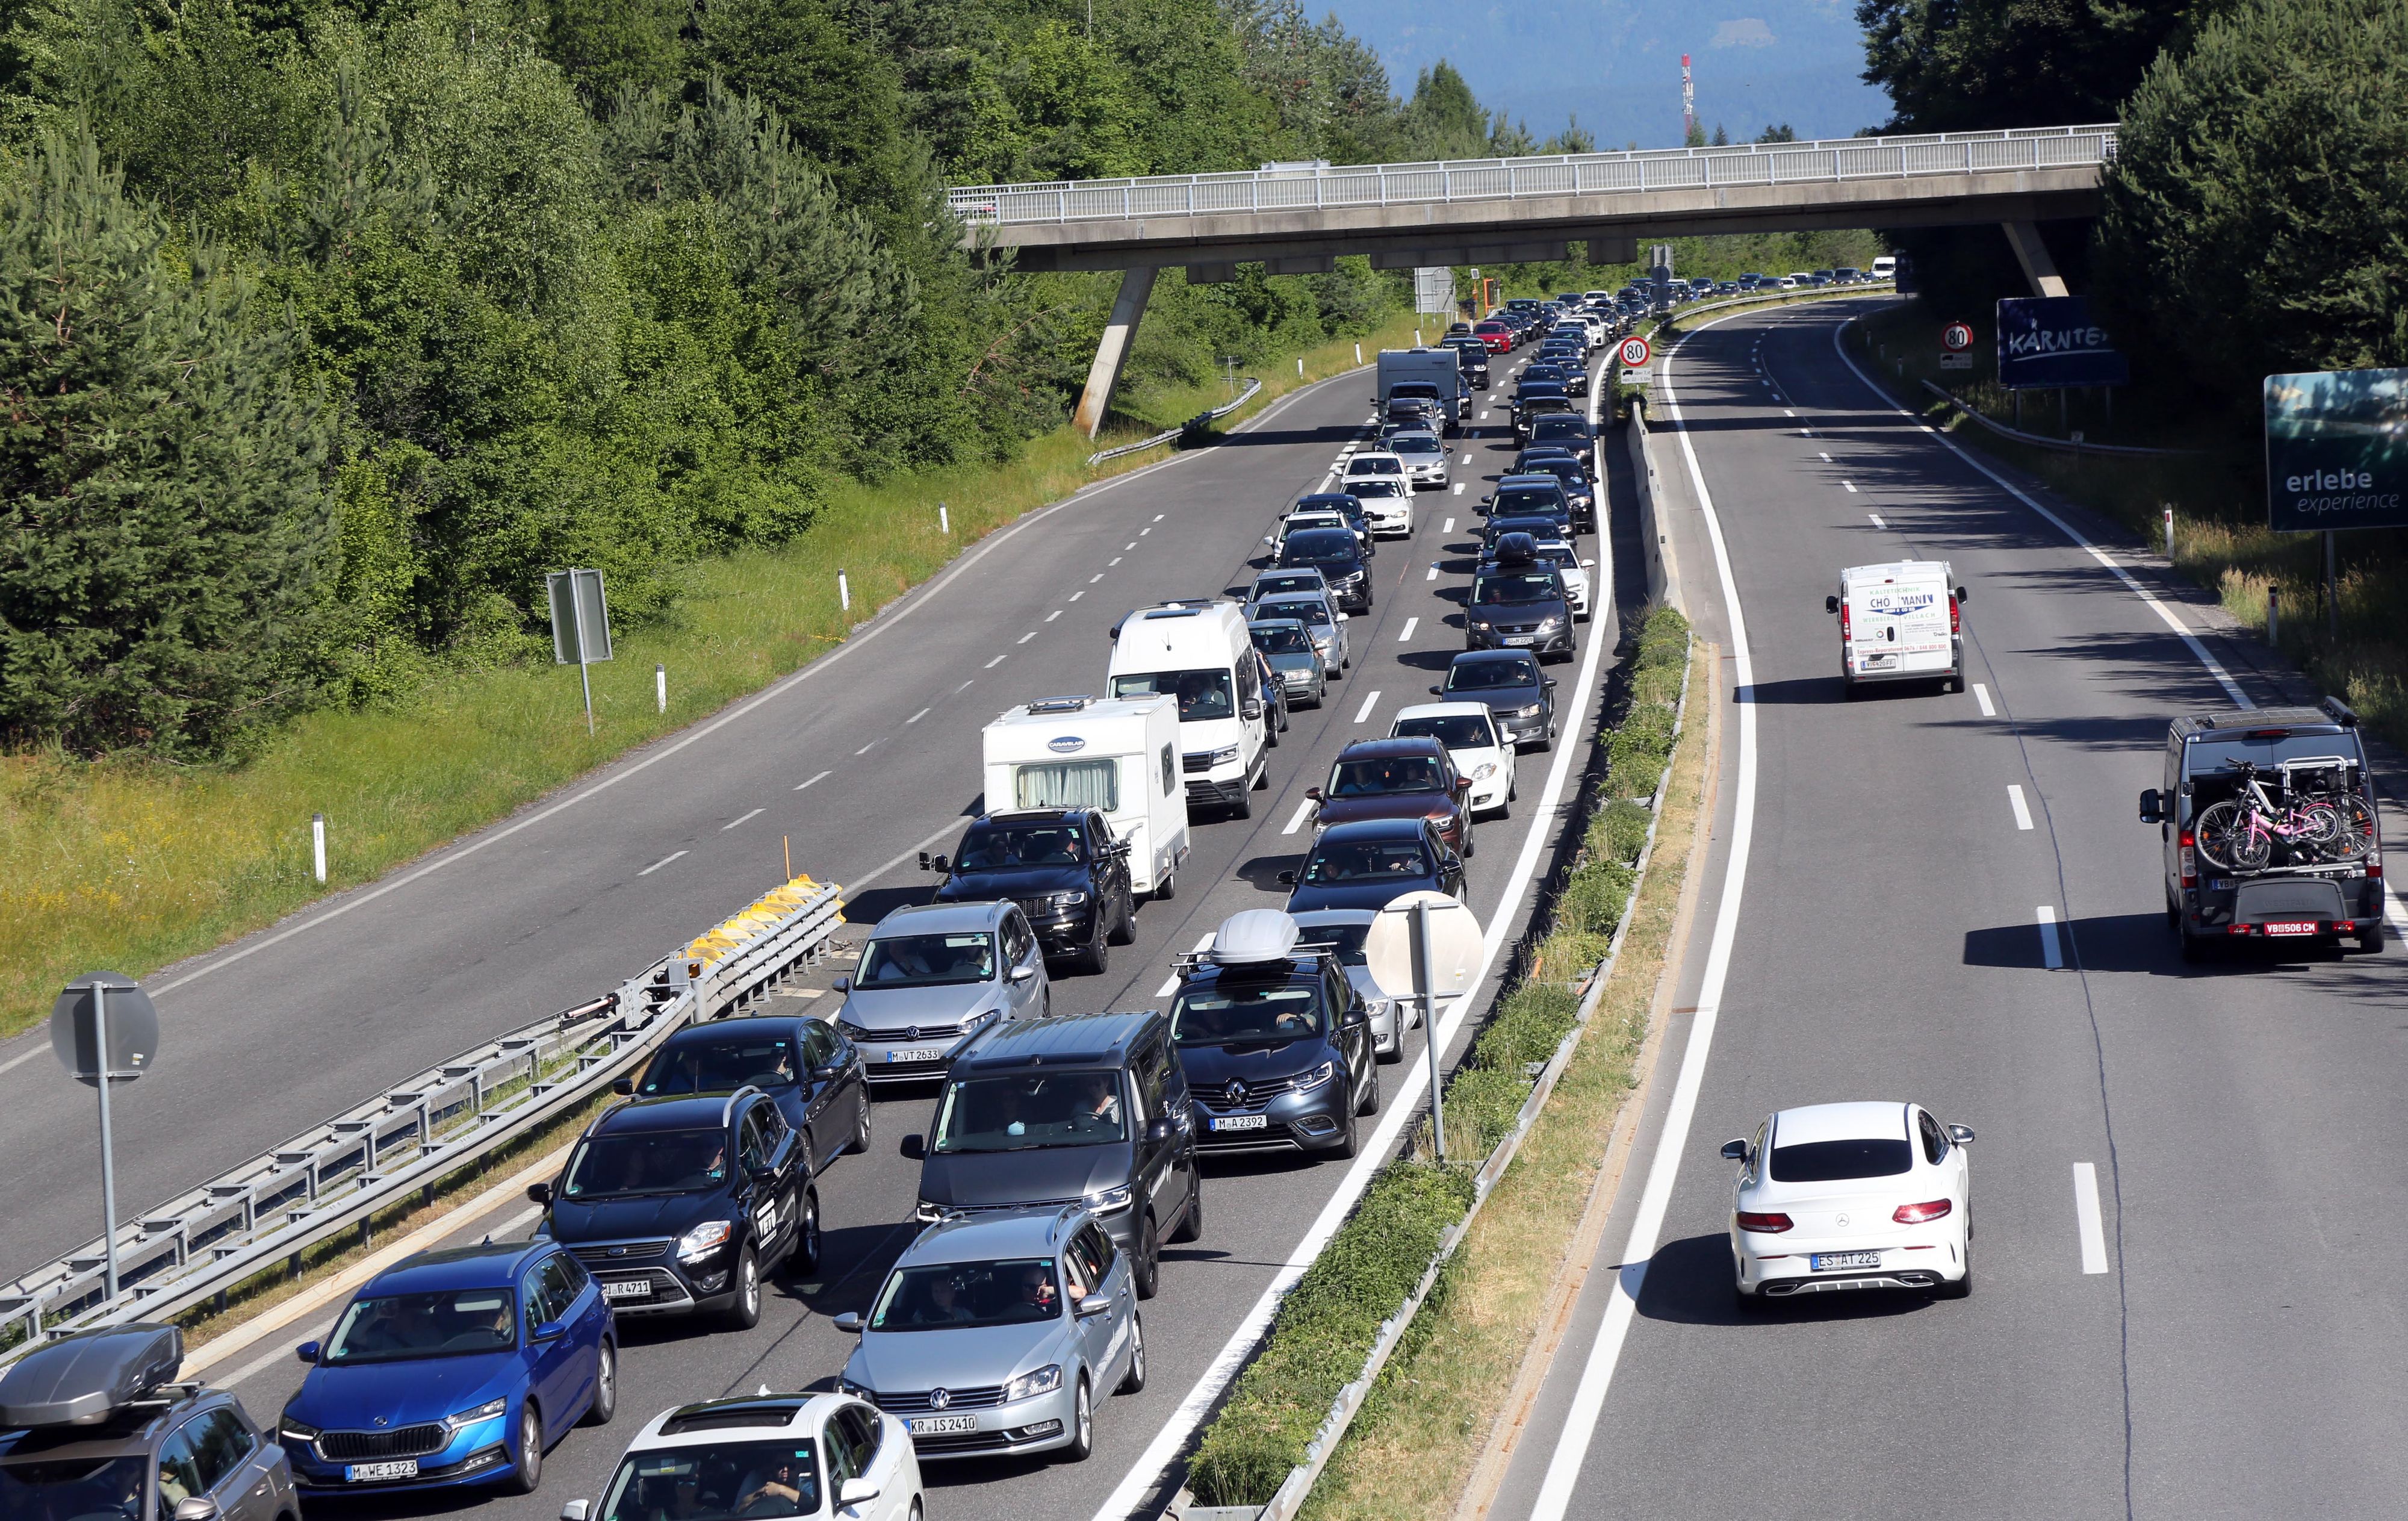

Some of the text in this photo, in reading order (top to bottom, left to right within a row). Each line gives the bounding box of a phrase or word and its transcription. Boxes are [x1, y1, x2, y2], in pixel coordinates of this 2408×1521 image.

[1948, 330, 1964, 345] 80
[2009, 318, 2109, 355] KÄRNTE
[1627, 344, 1642, 359] 80
[2286, 468, 2372, 492] erlebe
[2297, 492, 2399, 516] experience
[2267, 923, 2315, 933] VB 506 CM
[892, 1050, 937, 1061] M VT 2633
[1219, 1119, 1226, 1128] M
[1232, 1118, 1238, 1127] A
[1240, 1117, 1263, 1127] 2392
[759, 1208, 777, 1237] VETO
[1819, 1252, 1879, 1266] ES AT 225
[618, 1284, 624, 1294] R
[626, 1282, 649, 1293] 4711
[911, 1417, 975, 1433] KR IS 2410
[353, 1461, 416, 1478] M WE 1323
